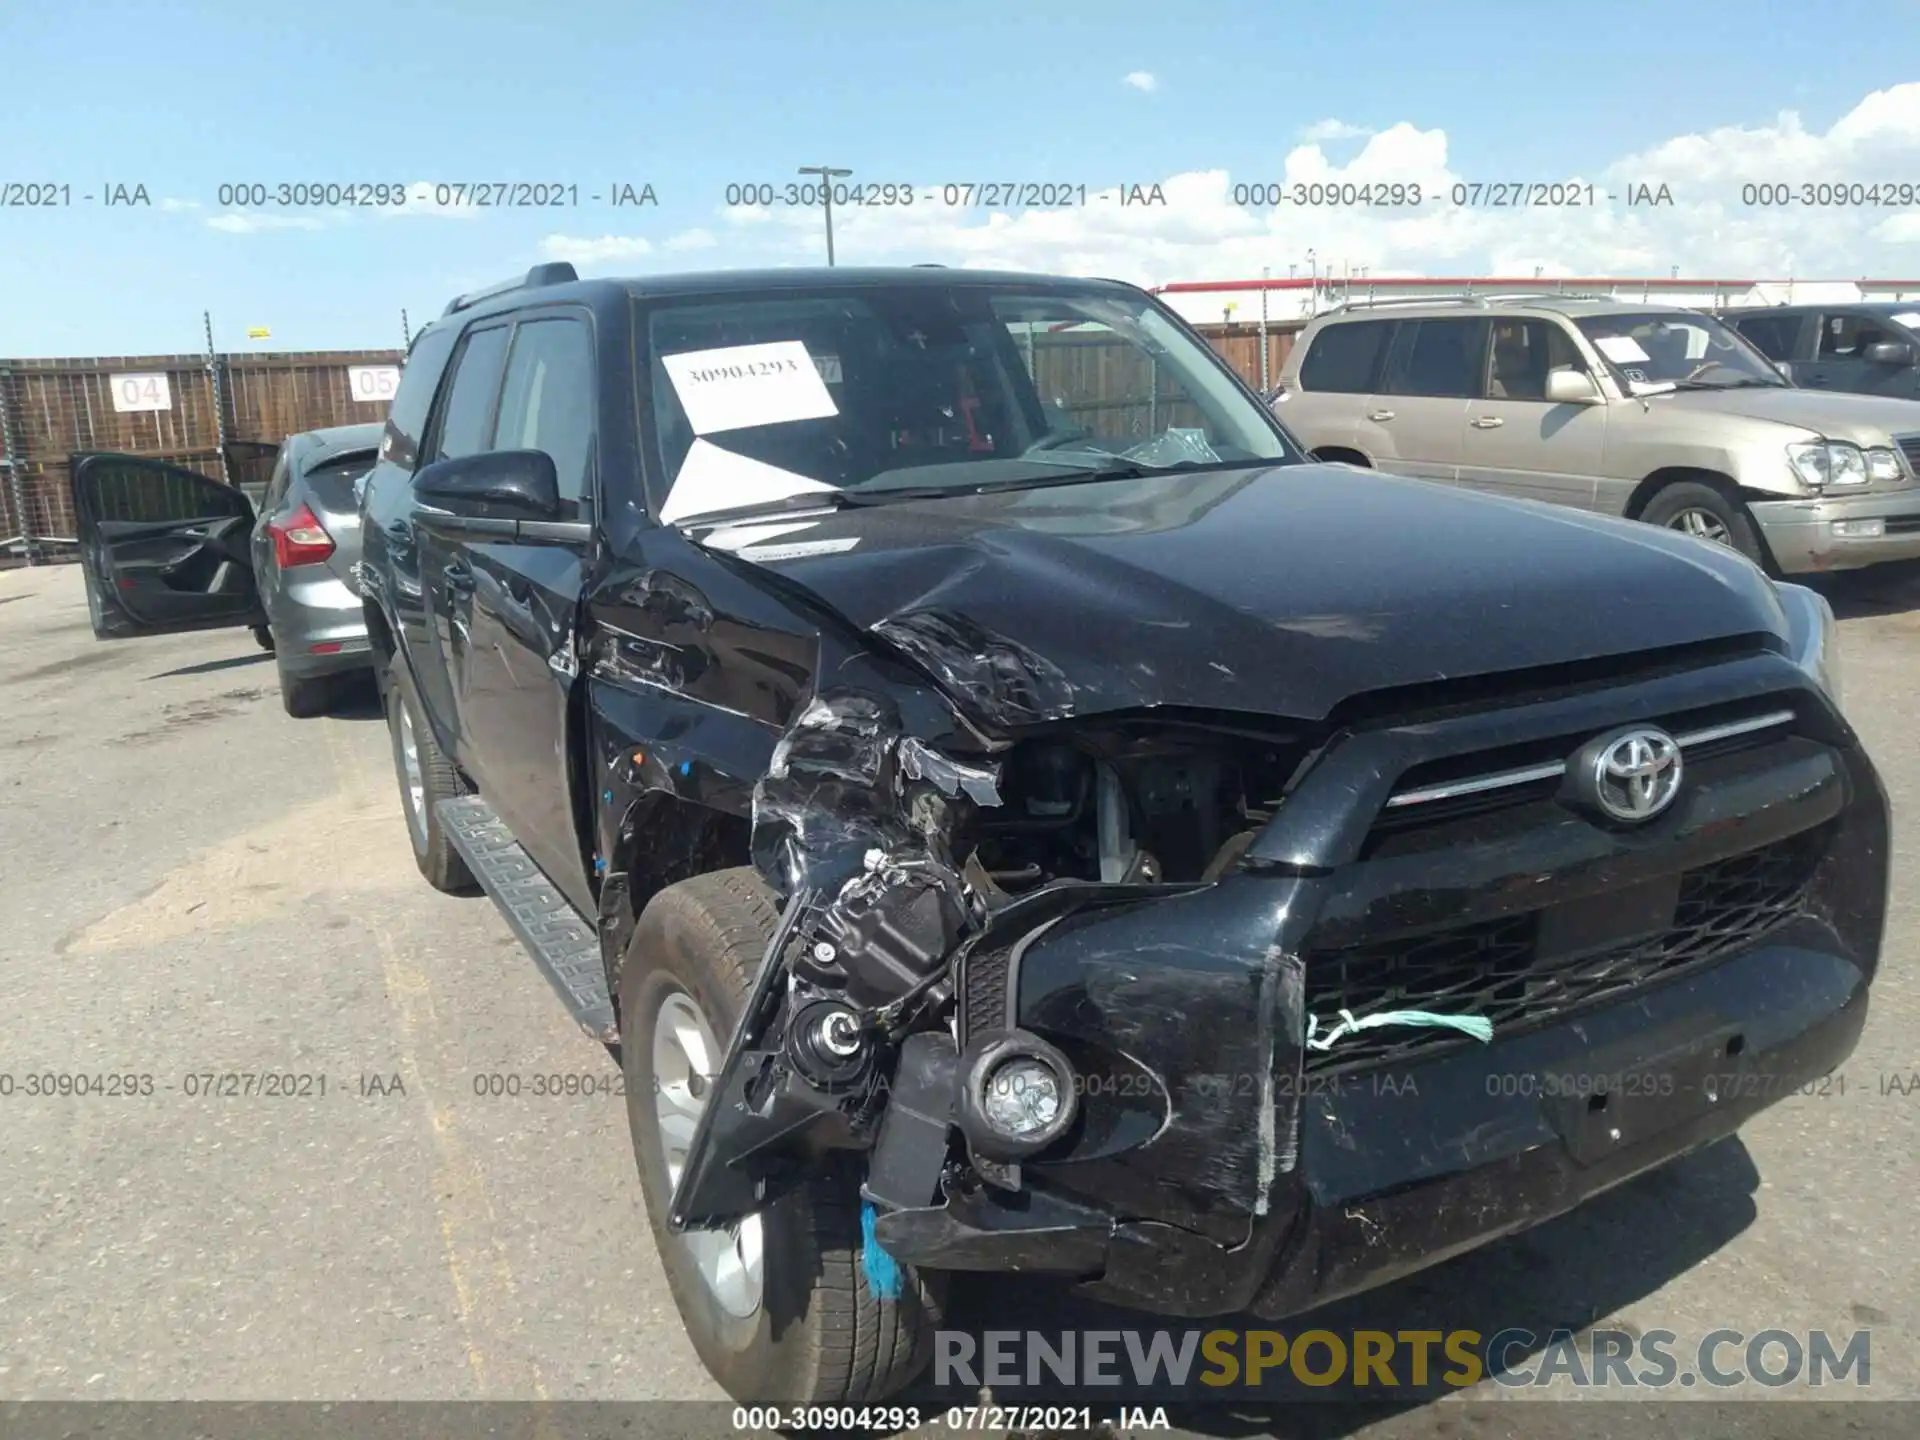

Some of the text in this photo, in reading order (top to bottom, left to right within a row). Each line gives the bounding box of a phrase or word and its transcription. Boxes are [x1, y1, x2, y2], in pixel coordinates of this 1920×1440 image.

[359, 371, 393, 394] 05
[688, 358, 797, 384] 30904293
[122, 379, 161, 405] 04
